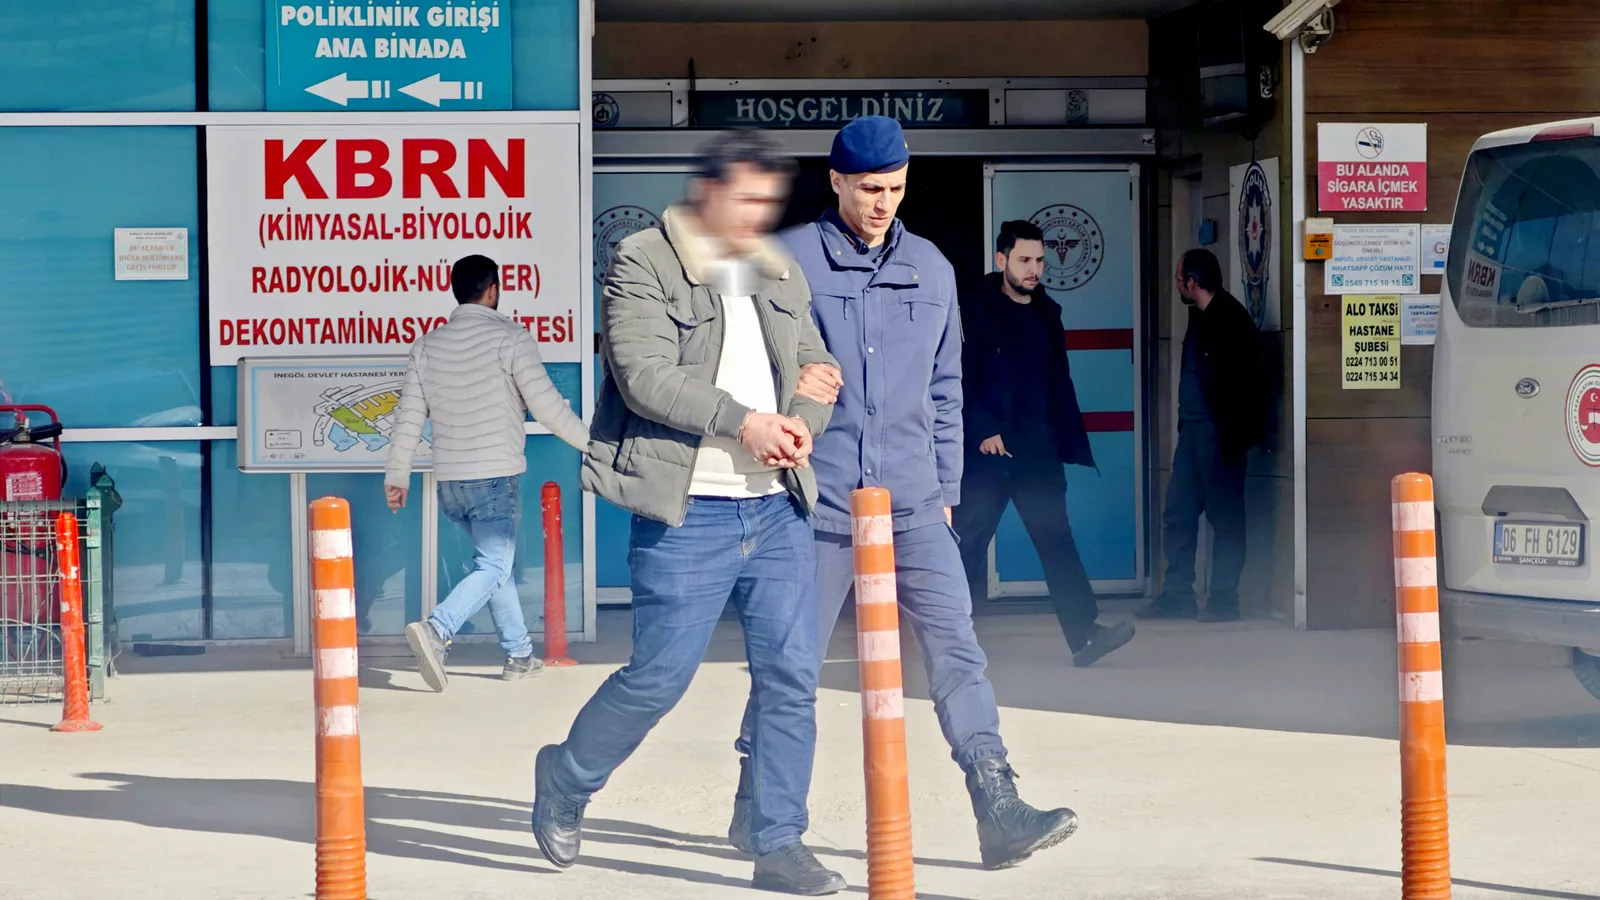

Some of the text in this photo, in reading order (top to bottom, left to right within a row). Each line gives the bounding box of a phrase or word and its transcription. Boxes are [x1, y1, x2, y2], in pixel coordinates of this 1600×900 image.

[281, 0, 500, 33] POLİKLİNİK GİRİŞİ
[314, 32, 467, 59] ANA BİNADA
[735, 92, 944, 127] HOŞGELDİNİZ
[264, 138, 526, 199] KBRN
[1336, 164, 1409, 176] BU ALANDA
[1327, 178, 1418, 196] SİGARA İÇMEK
[1341, 197, 1404, 209] YASAKTIR
[258, 206, 533, 249] (KİMYASAL-BİYOLOJİK
[1369, 264, 1393, 272] ÇÖZÜM
[251, 258, 541, 299] RADYOLOJİK-NÜER)
[1346, 303, 1366, 316] ALO
[1349, 325, 1394, 336] HASTANE
[1345, 357, 1398, 367] 0224 713 00 51
[1345, 372, 1398, 382] 0224 715 34 34
[1503, 527, 1577, 555] 06 FH 6129
